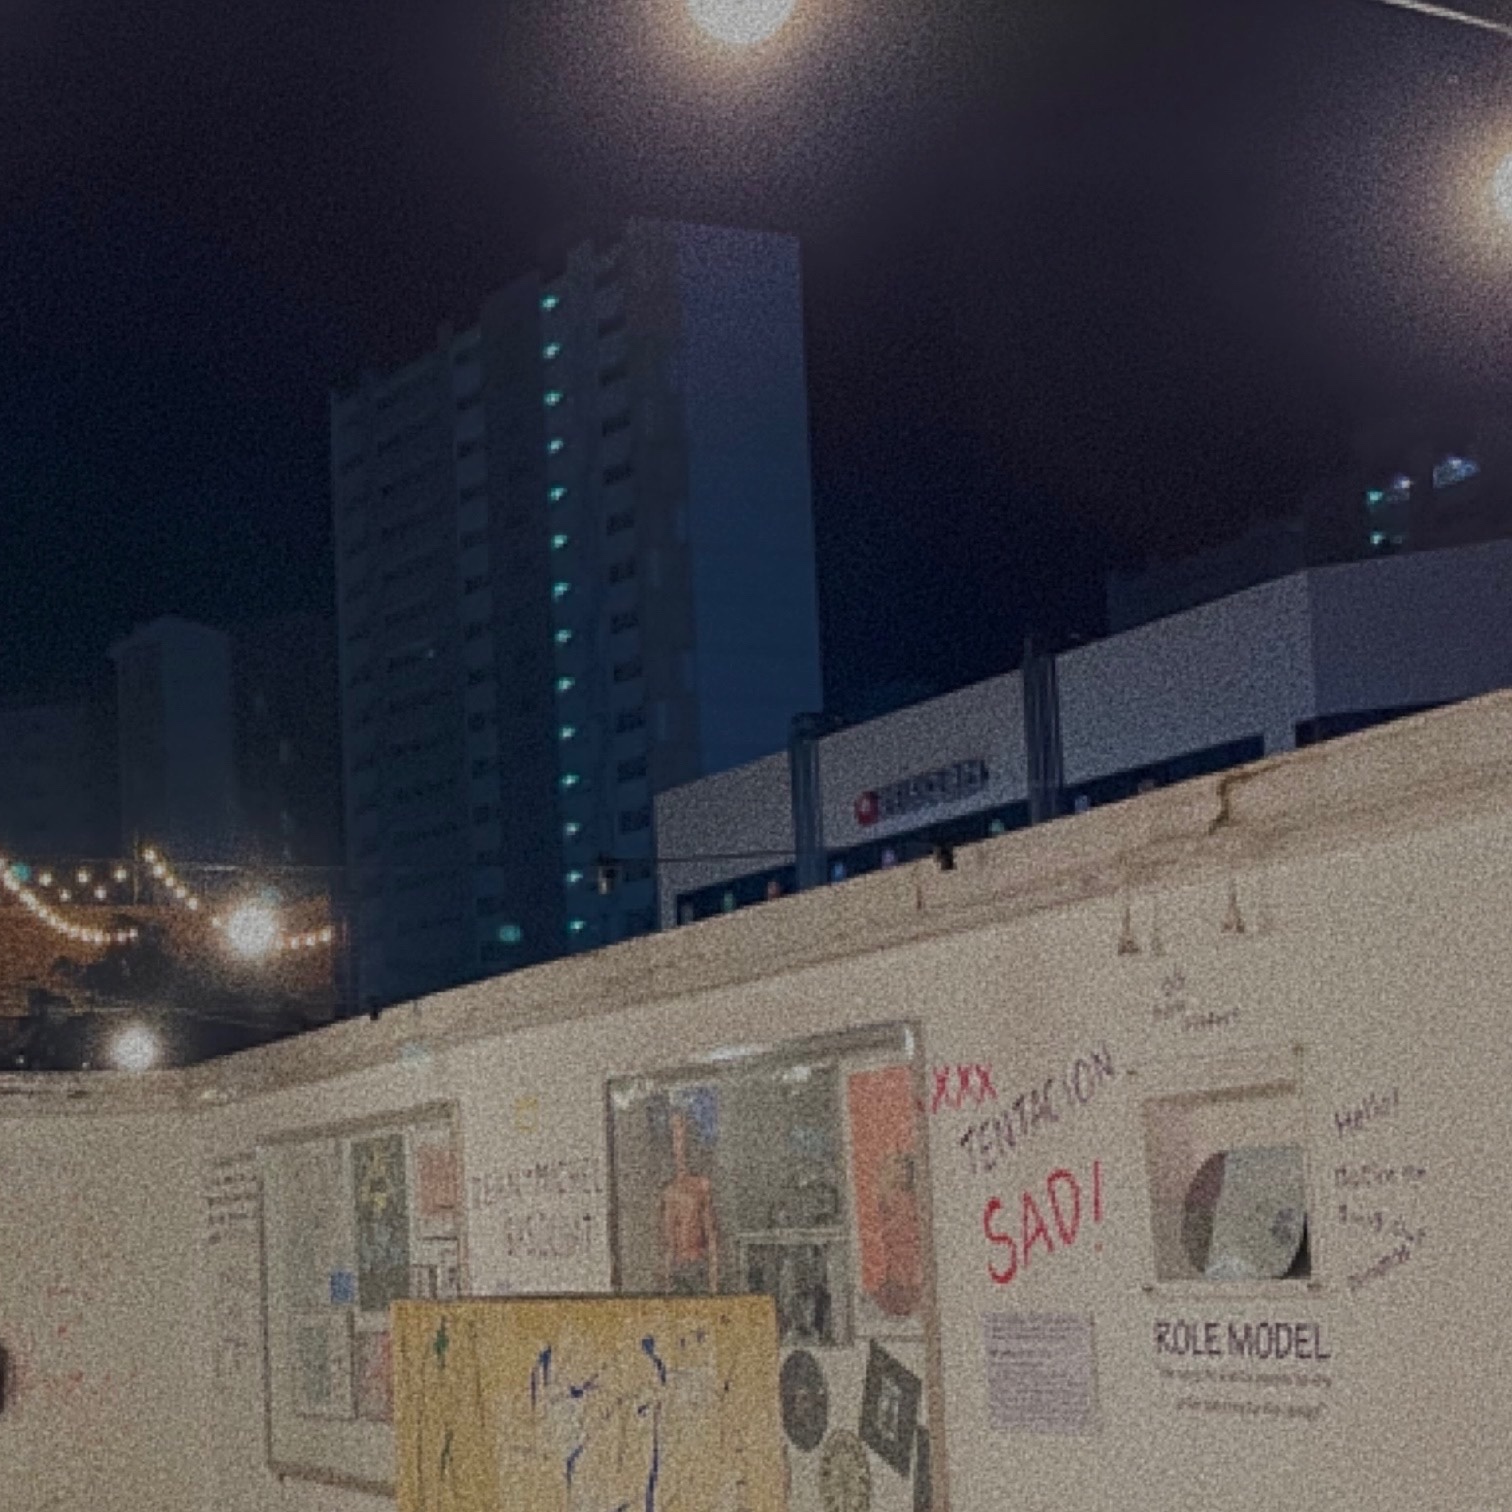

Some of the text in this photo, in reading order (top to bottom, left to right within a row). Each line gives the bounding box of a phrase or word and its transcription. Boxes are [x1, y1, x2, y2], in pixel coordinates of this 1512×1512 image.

[983, 1159, 1103, 1285] SAD!
[1153, 1319, 1331, 1361] ROLE MODEL
